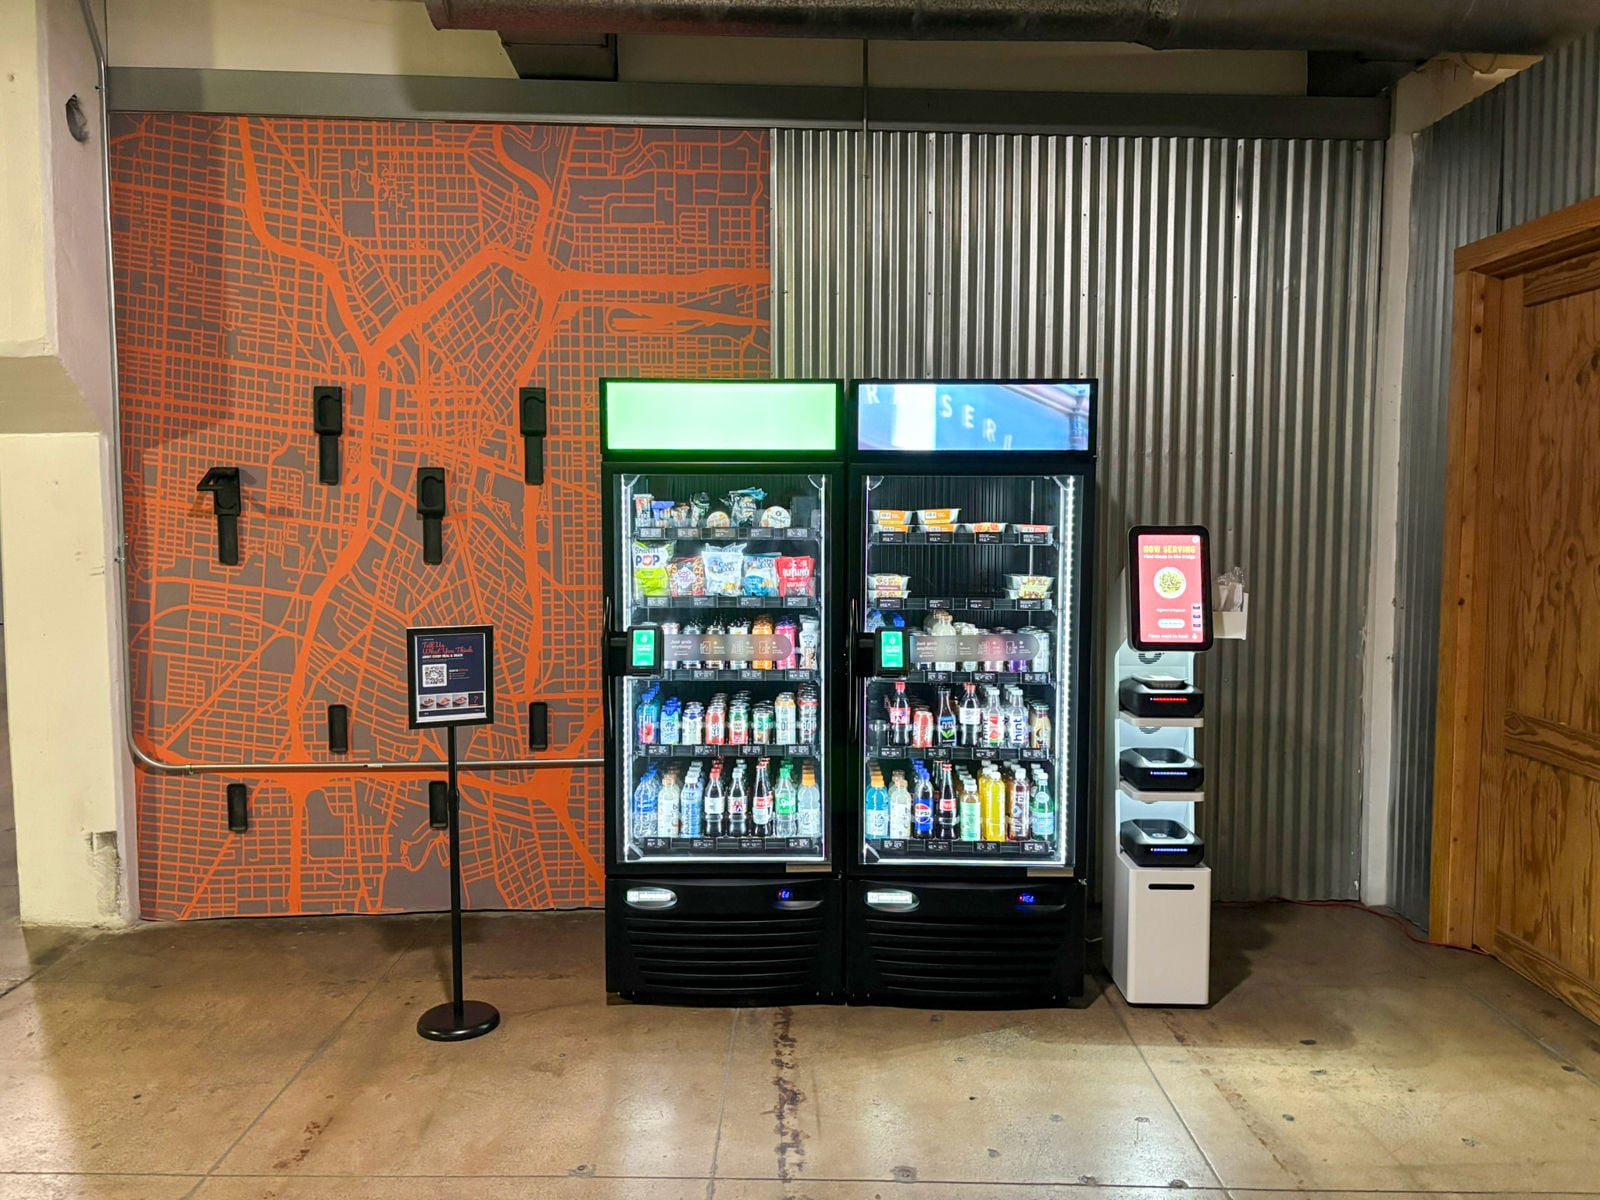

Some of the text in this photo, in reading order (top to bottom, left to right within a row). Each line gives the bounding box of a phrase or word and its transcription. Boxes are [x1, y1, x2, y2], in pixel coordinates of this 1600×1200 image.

[1143, 545, 1196, 554] NOW SERVING
[635, 555, 660, 567] POP
[1013, 718, 1023, 742] hint
